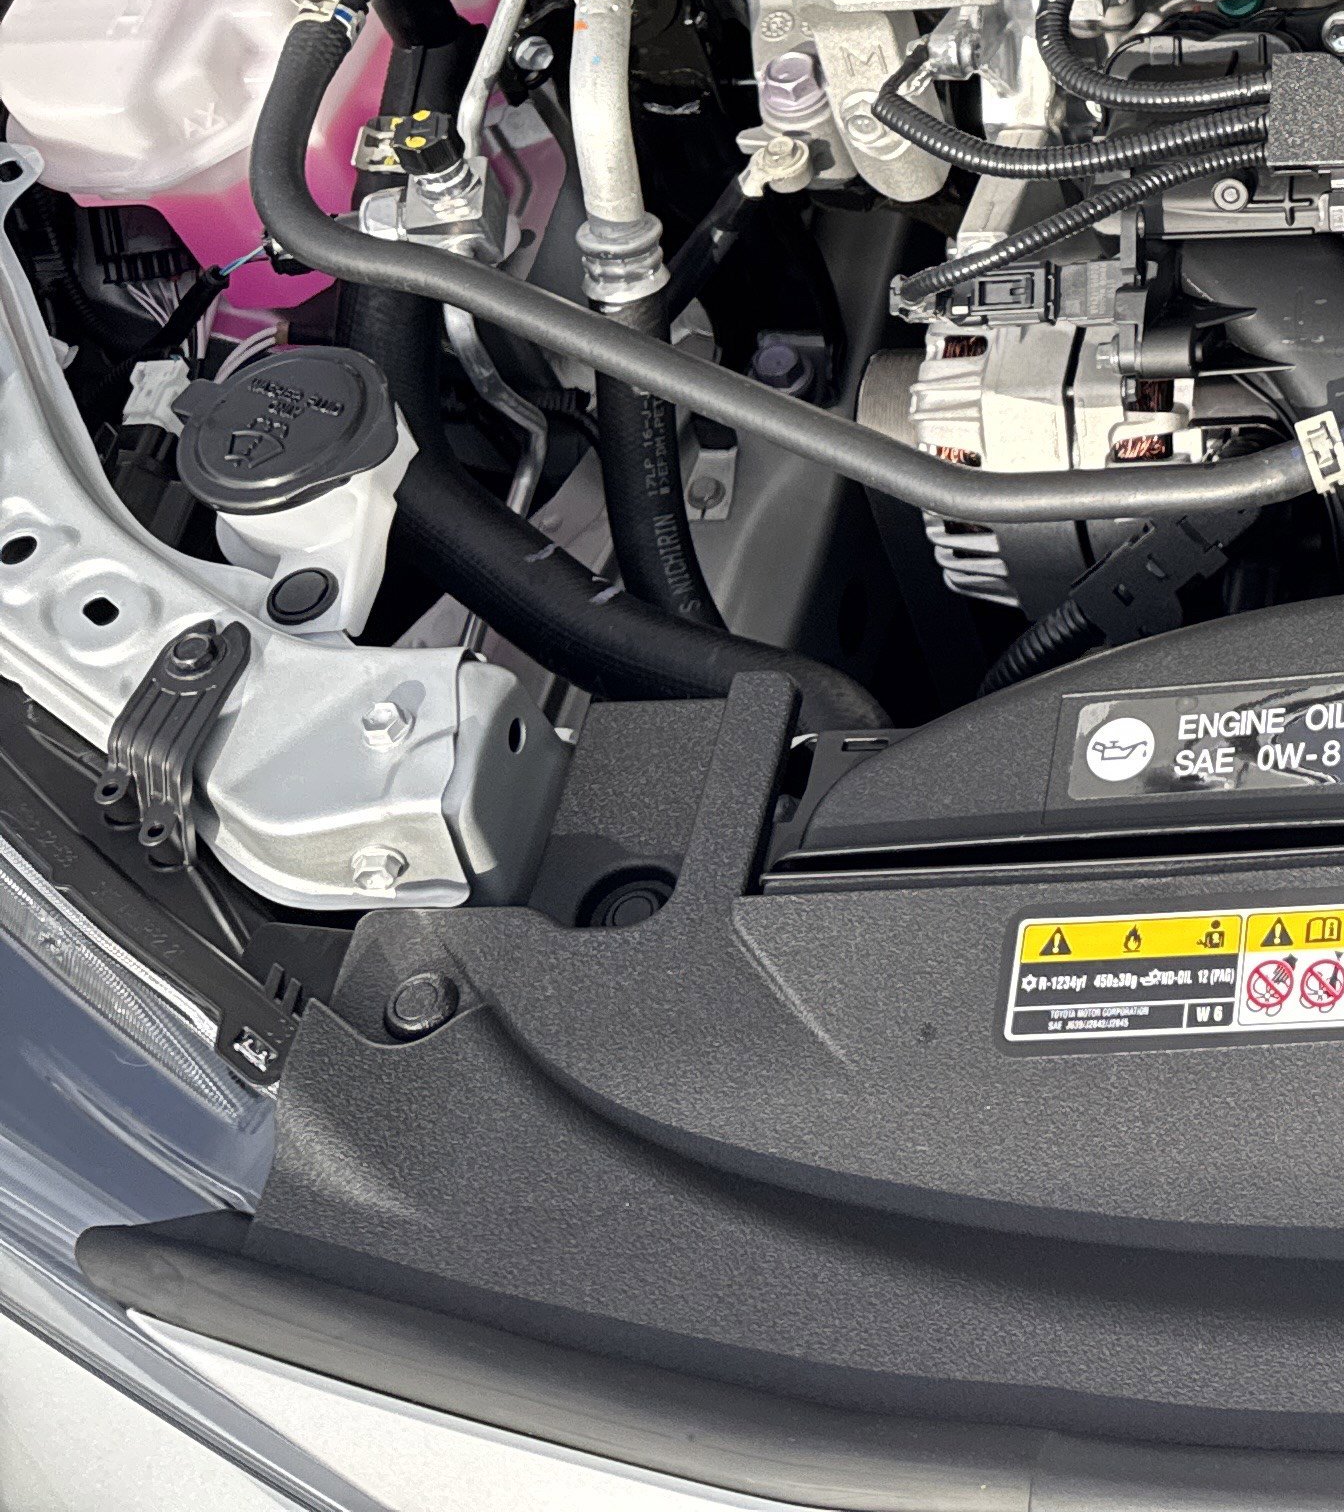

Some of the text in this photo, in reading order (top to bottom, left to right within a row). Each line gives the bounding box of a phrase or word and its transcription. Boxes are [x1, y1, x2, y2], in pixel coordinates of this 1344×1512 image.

[652, 513, 695, 596] NICHIRIN
[1177, 707, 1287, 741] ENGINE
[1173, 739, 1341, 777] SAE 0W-8
[1038, 974, 1088, 992] R-1234yf
[1197, 969, 1209, 984] 12
[1210, 968, 1235, 986] (PAG)
[1050, 1006, 1150, 1020] TOYOTA MOTOR CORPORATION
[1195, 1005, 1224, 1022] W 6
[1047, 1020, 1063, 1031] SAE
